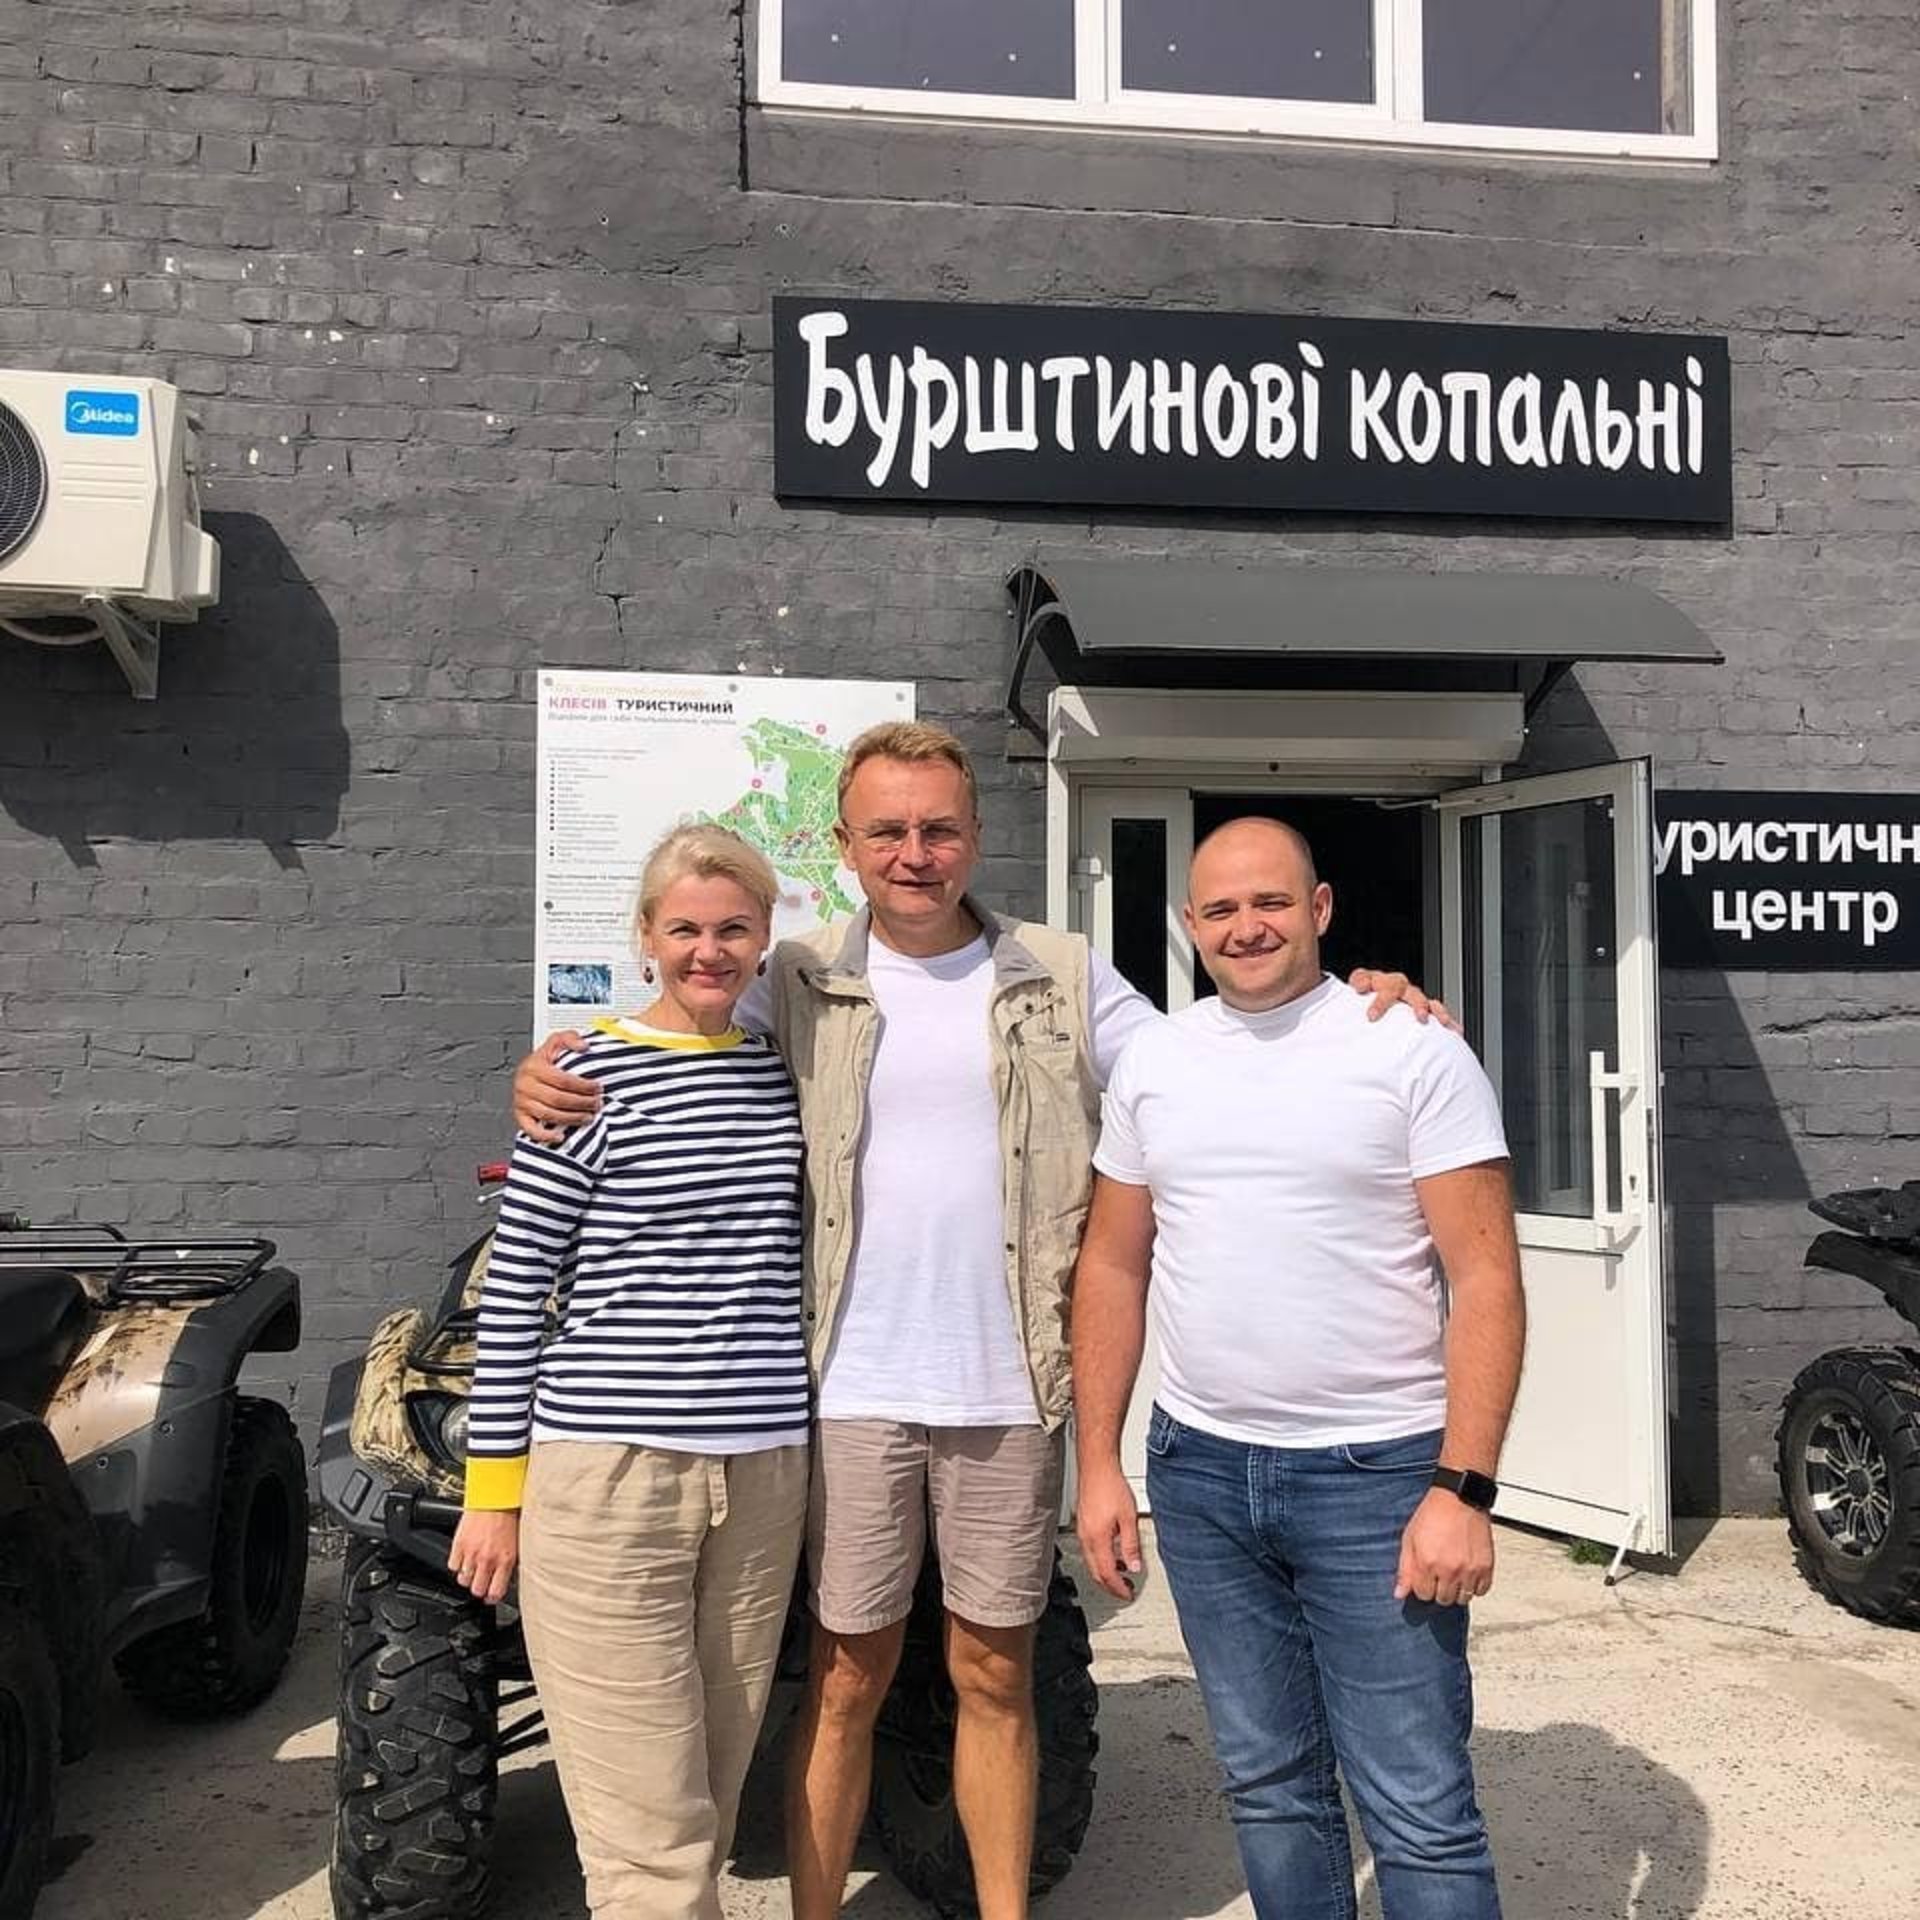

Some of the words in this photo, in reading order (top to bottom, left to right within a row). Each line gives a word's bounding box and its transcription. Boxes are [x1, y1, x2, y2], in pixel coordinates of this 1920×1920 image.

[70, 402, 134, 424] Midea
[799, 311, 1323, 488] Бурштинові
[1351, 356, 1702, 473] копальні
[549, 696, 607, 709] КЛЕСІВ
[616, 699, 733, 714] ТУРИСТИЧНИЙ
[1713, 890, 1898, 946] центр
